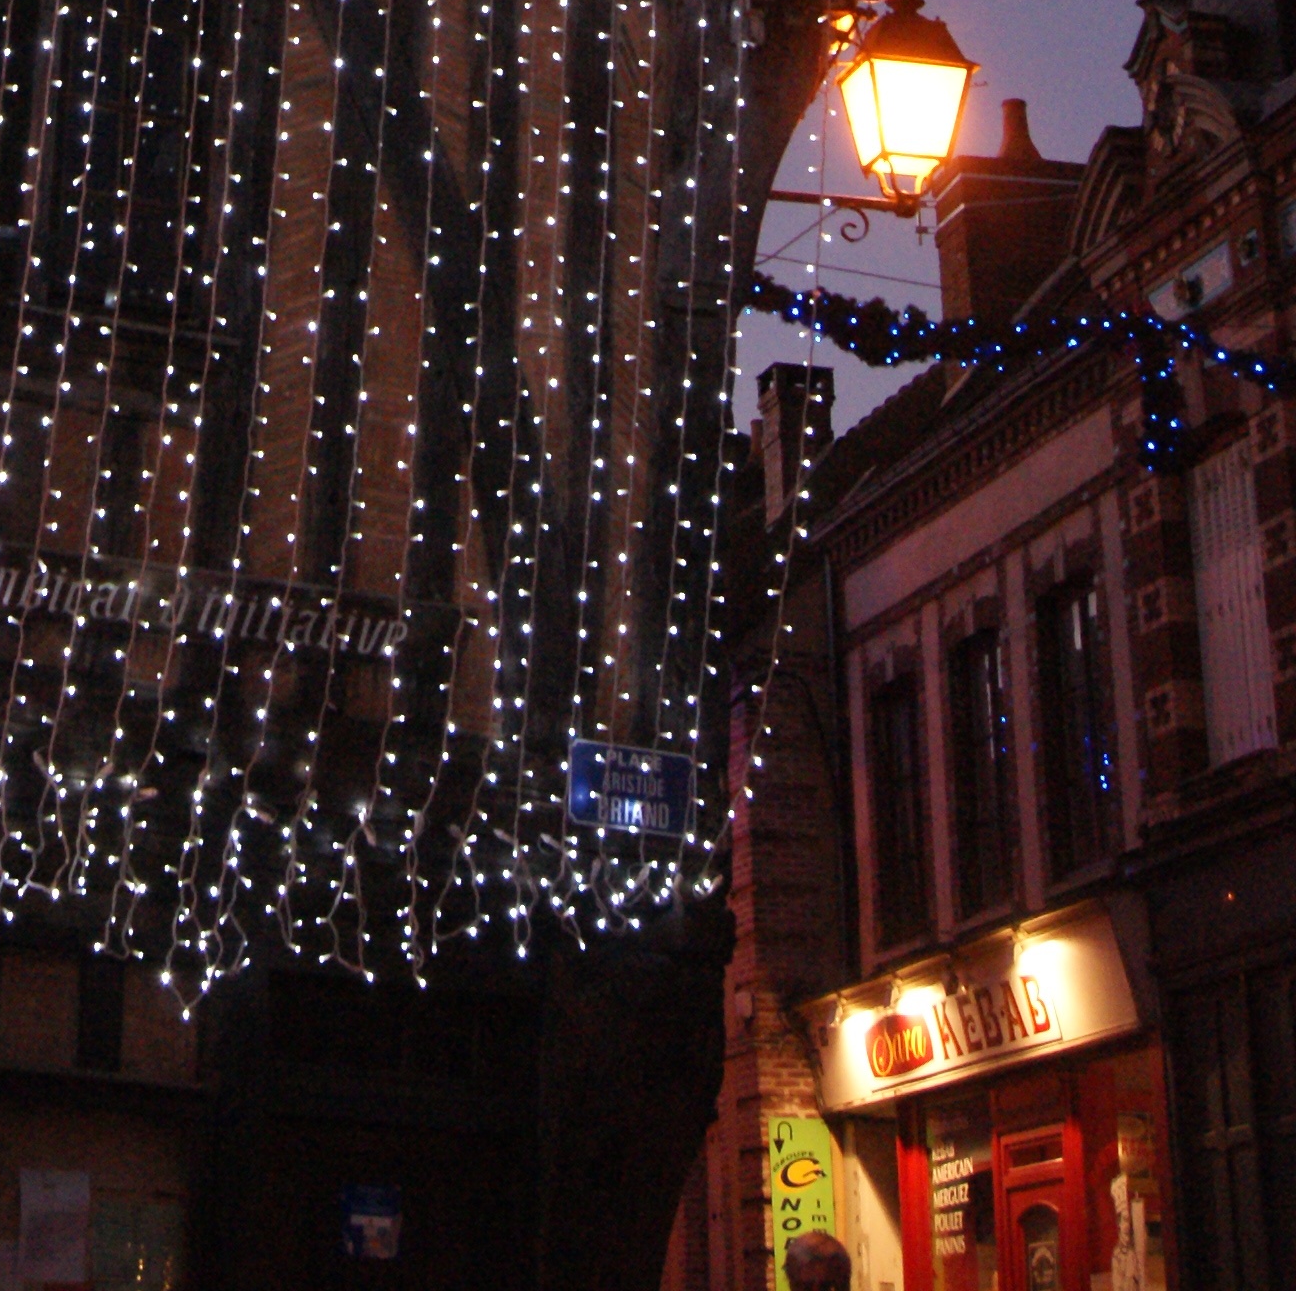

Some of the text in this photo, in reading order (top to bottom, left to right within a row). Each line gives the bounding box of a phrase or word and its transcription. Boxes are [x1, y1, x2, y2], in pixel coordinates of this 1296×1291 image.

[606, 748, 662, 772] PLACE
[602, 771, 664, 799] ARISTIDE
[598, 793, 670, 829] BRIAND
[933, 975, 1052, 1061] KEBAB
[932, 1156, 974, 1185] AMERICAIN
[933, 1182, 970, 1209] MERGUEZ
[934, 1210, 964, 1233] POULET
